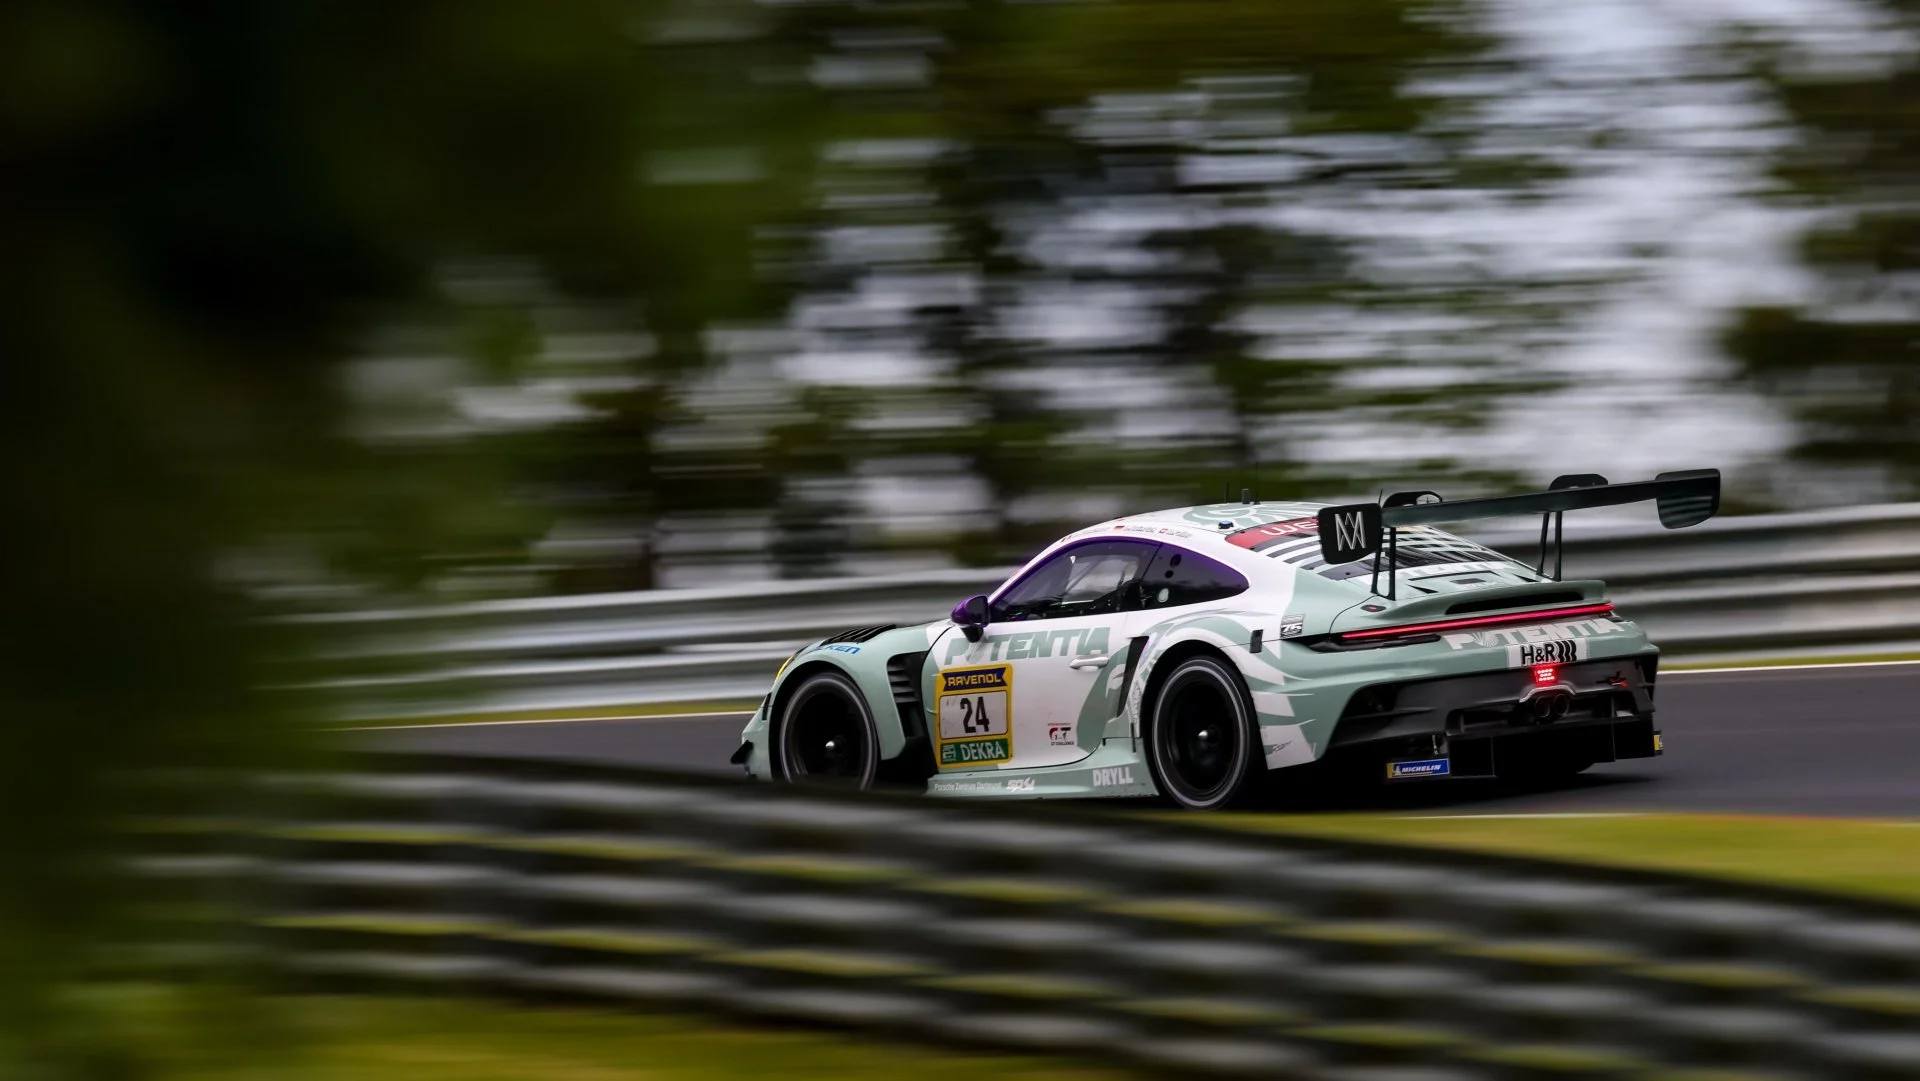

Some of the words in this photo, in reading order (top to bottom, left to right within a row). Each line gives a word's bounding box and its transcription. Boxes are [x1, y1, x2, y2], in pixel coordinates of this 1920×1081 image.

[947, 672, 1001, 687] RAVENOL
[960, 696, 990, 734] 24
[960, 741, 1005, 761] DEKRA
[1092, 767, 1133, 787] DRYLL
[1402, 765, 1441, 773] MICHELIN
